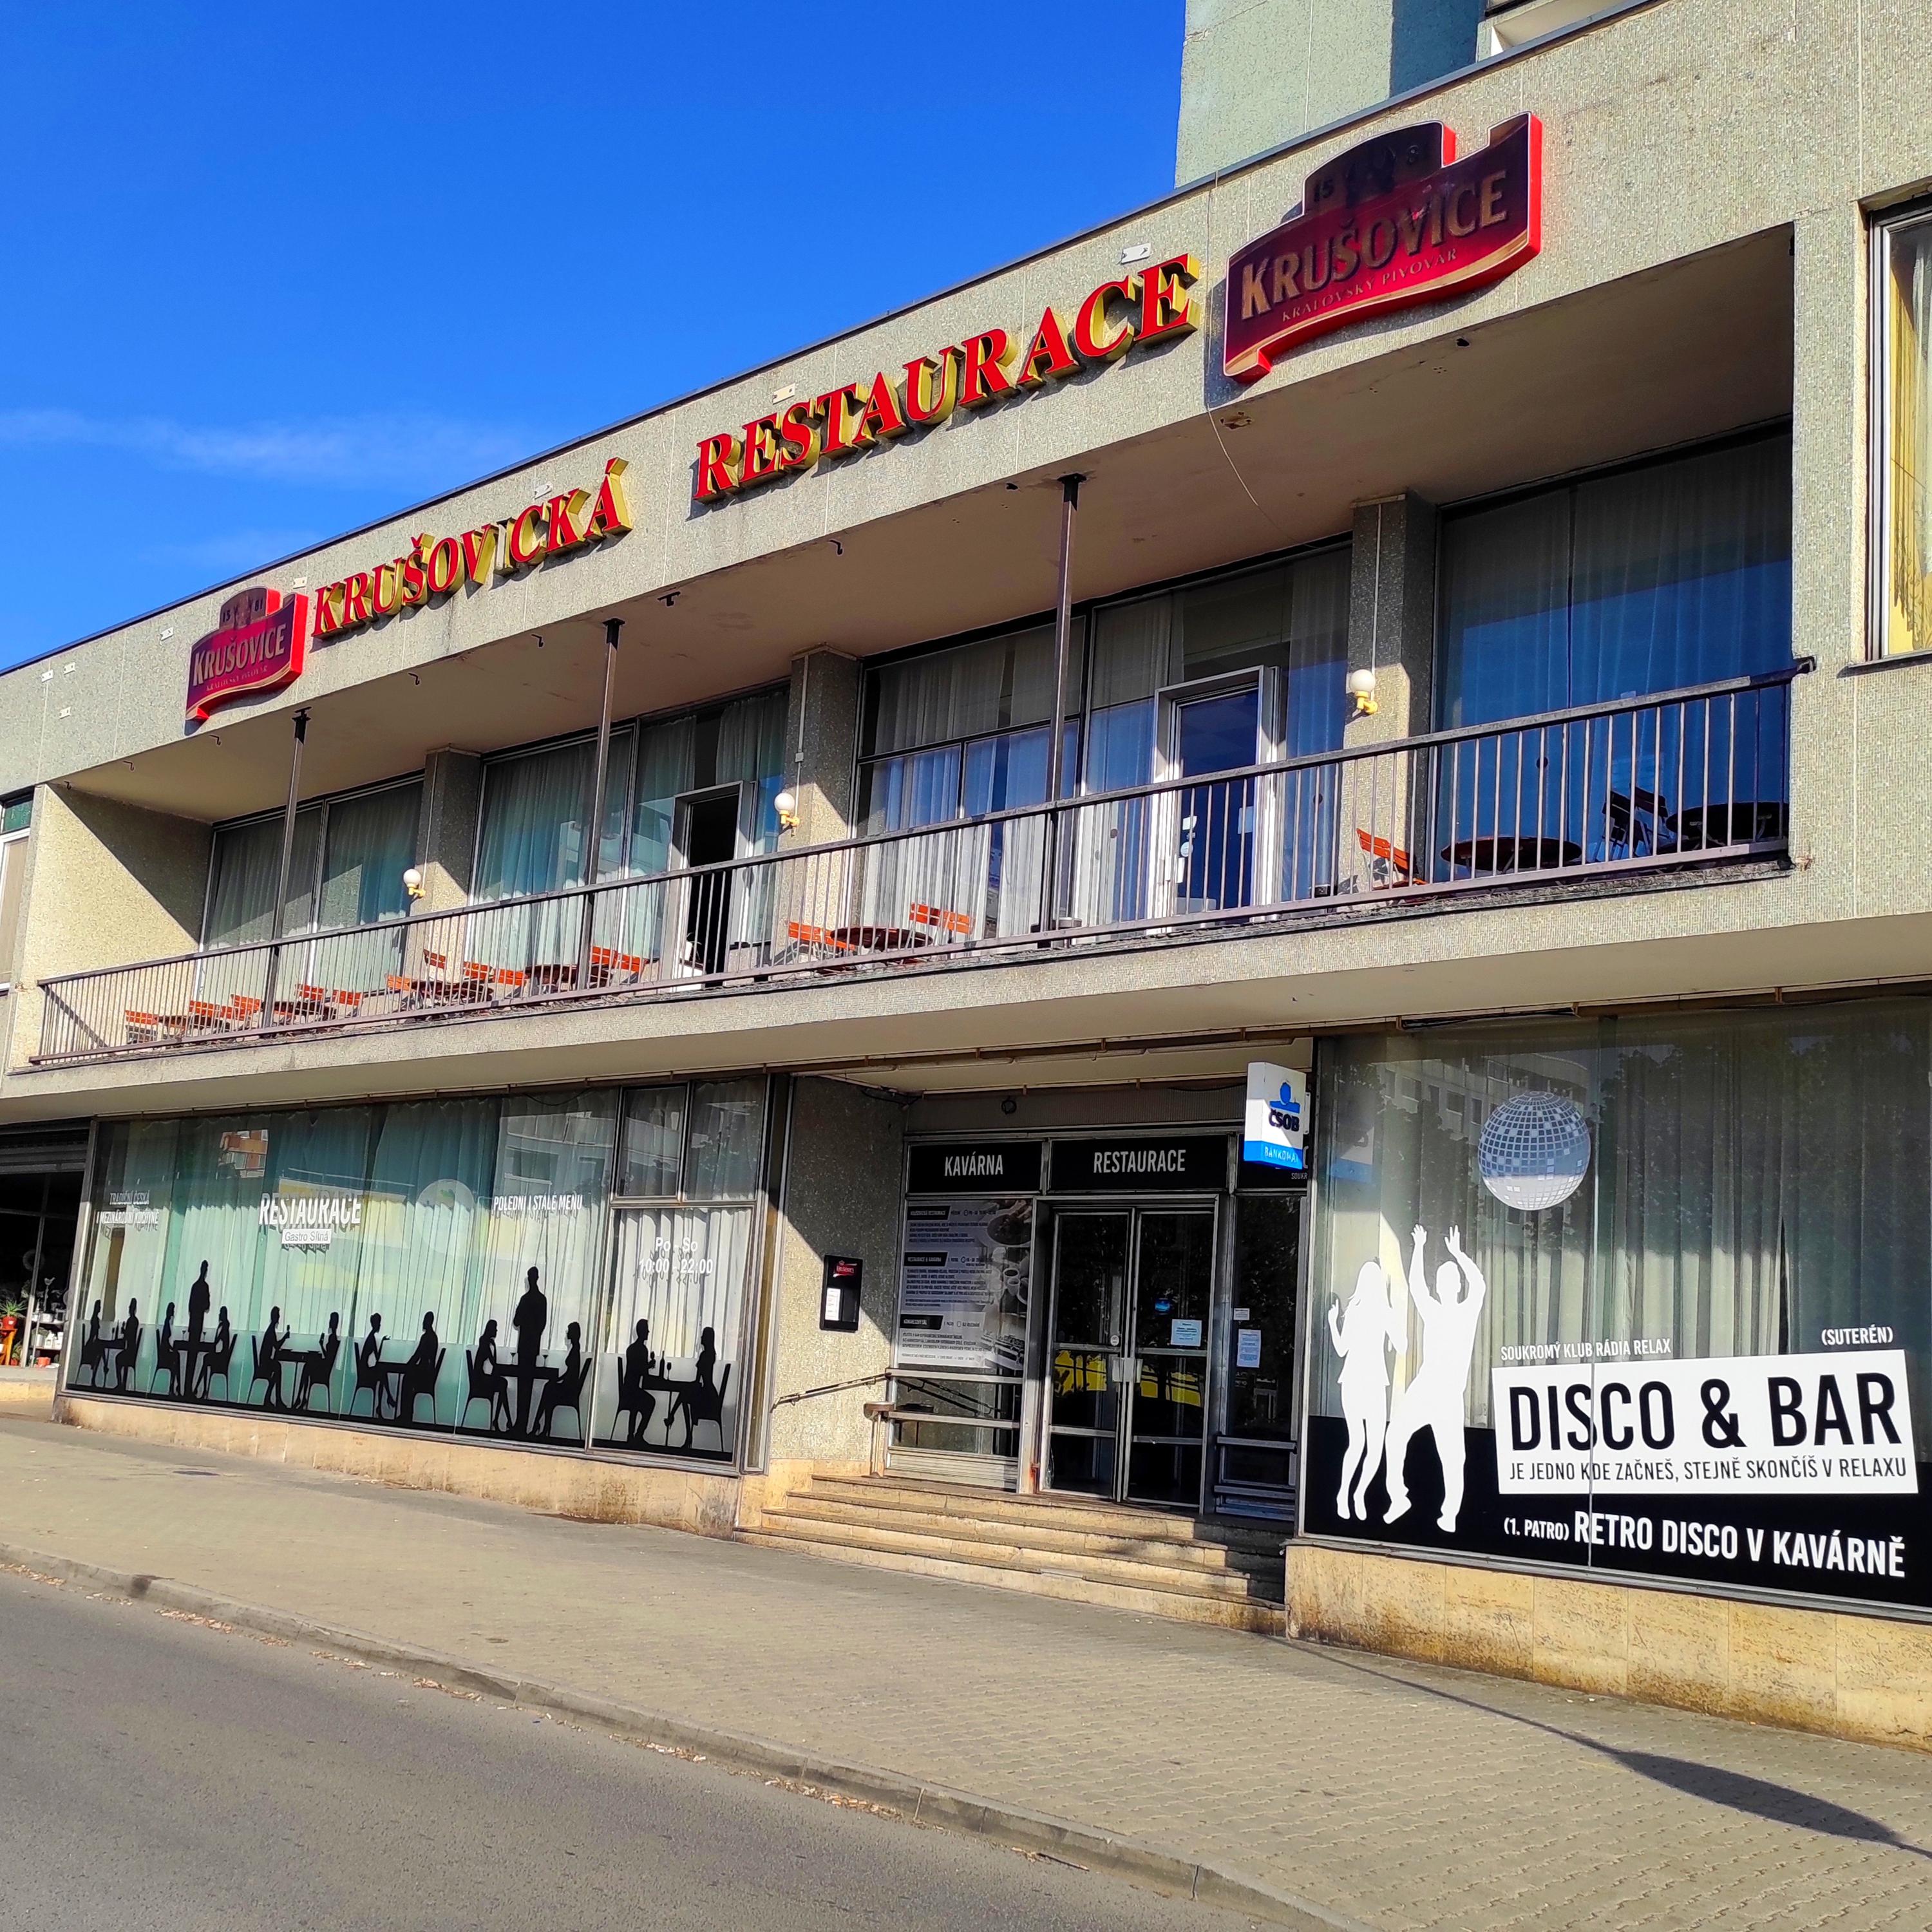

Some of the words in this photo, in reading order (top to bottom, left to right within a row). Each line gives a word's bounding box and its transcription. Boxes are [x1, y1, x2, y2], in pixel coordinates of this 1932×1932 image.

[1241, 170, 1508, 321] KRUŠOVICE
[1382, 248, 1457, 285] PIVOVAR
[692, 253, 1200, 504] RESTAURACE
[312, 457, 633, 639] KRUŠOVICKÁ
[193, 623, 287, 687] KRUŠOVICE
[1269, 1108, 1300, 1132] ČSOB
[944, 1151, 1003, 1176] KAVÁRNA
[1094, 1150, 1186, 1173] RESTAURACE
[259, 1191, 363, 1225] RESTAURACE
[527, 1195, 531, 1209] I
[558, 1195, 583, 1210] MENU
[285, 1231, 308, 1242] Gastro
[655, 1237, 671, 1251] Po
[682, 1237, 697, 1252] So
[639, 1258, 670, 1273] 10:00
[680, 1258, 713, 1273] 22:00
[1821, 1325, 1893, 1347] (SUTERÉN)
[1501, 1341, 1561, 1361] SOUKROMÝ
[1564, 1342, 1593, 1358] KLUB
[1596, 1338, 1631, 1356] RÁDIA
[1633, 1338, 1672, 1355] RELAX
[1509, 1381, 1675, 1451] DISCO
[1700, 1378, 1747, 1448] &
[1767, 1372, 1902, 1446] BAR
[1510, 1463, 1524, 1480] JE
[1530, 1463, 1575, 1480] JEDNO
[1580, 1463, 1611, 1480] KDE
[1615, 1458, 1679, 1482] ZAČNEŠ,
[1683, 1457, 1741, 1480] STEJNĚ
[1746, 1455, 1817, 1479] SKONČÍŠ
[1823, 1458, 1832, 1477] V
[1839, 1457, 1907, 1477] RELAXU
[1504, 1517, 1520, 1536] (1.
[1524, 1519, 1569, 1541] PATRO)
[1575, 1511, 1653, 1550] RETRO
[1662, 1519, 1738, 1560] DISCO
[1746, 1528, 1765, 1562] V
[1773, 1529, 1906, 1578] KAVÁRNĚ
